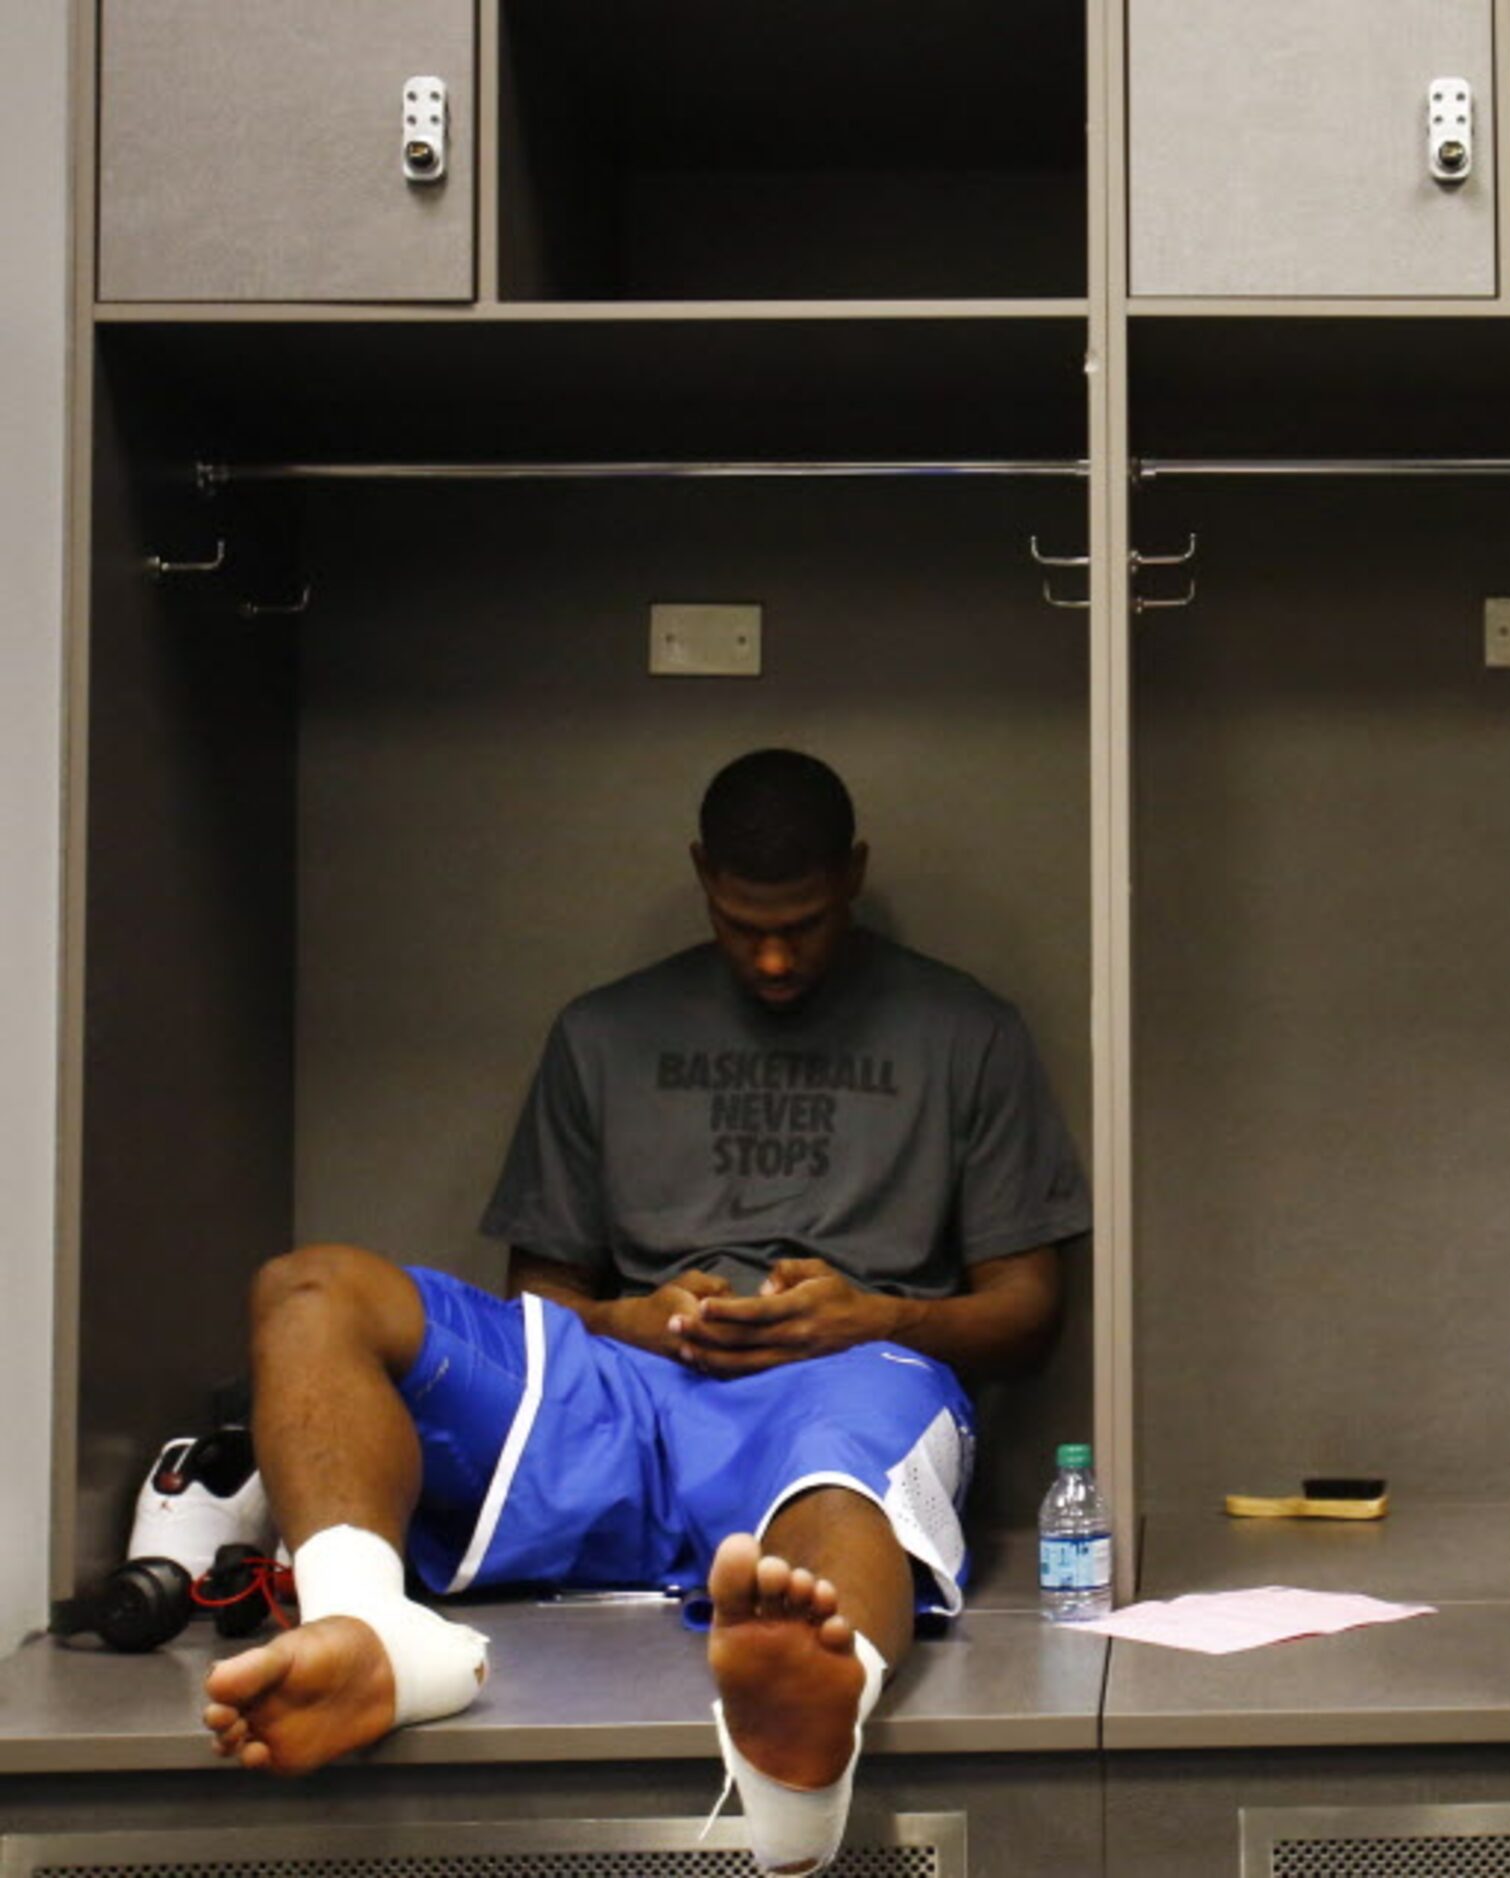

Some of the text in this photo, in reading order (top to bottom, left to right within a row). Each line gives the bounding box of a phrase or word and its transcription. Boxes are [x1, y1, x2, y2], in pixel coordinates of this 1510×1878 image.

[657, 1051, 898, 1096] BASKETBALL
[711, 1092, 837, 1133] NEVER
[712, 1135, 831, 1178] STOPS
